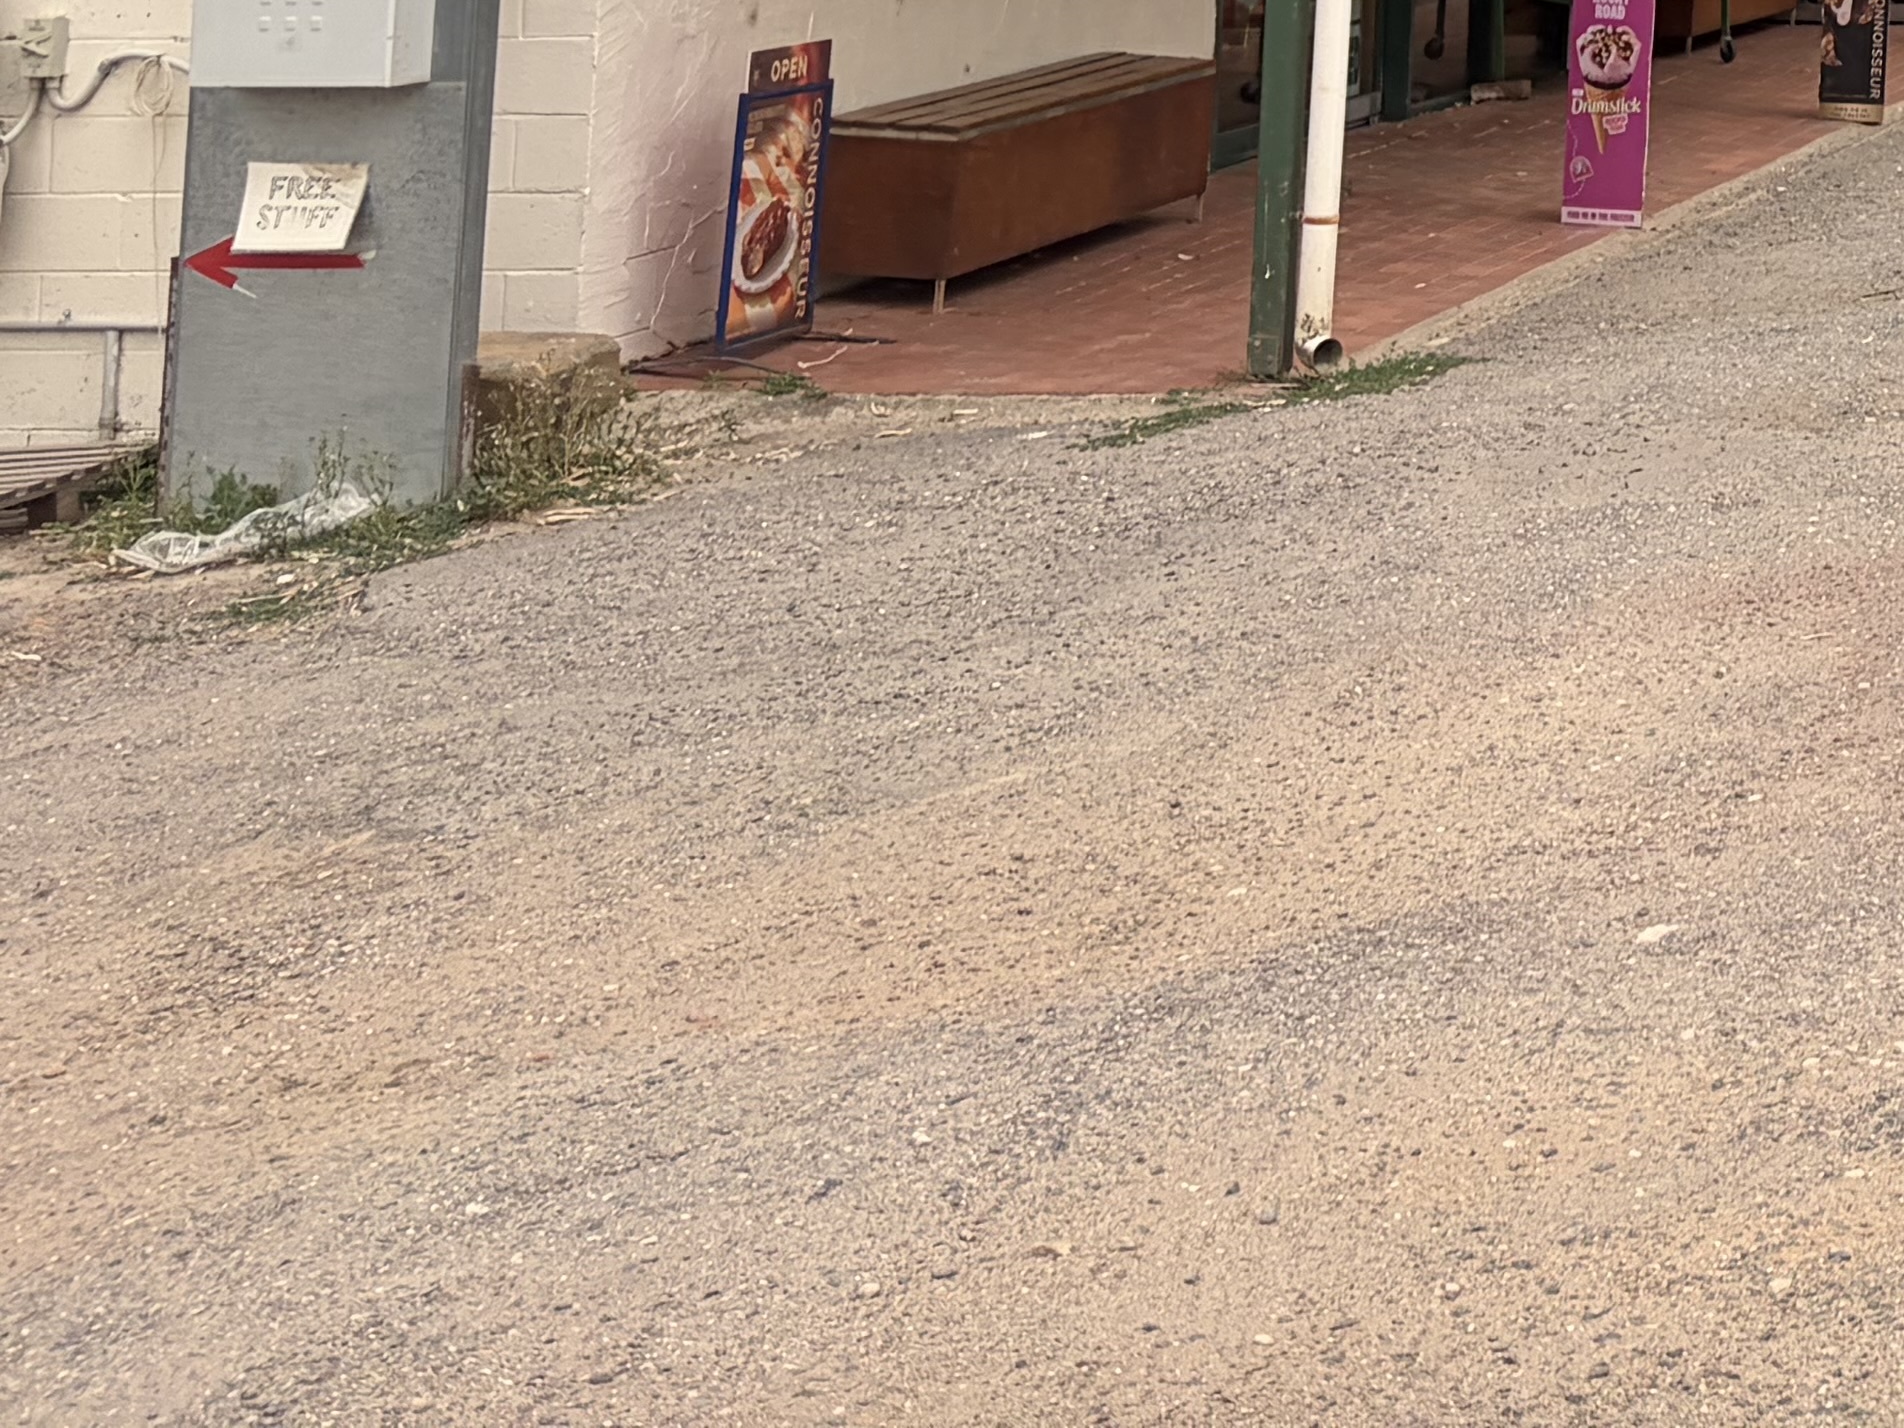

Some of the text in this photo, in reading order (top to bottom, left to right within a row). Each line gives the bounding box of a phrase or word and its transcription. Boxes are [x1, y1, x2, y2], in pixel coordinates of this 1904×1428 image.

[1595, 4, 1625, 20] ROAD
[770, 55, 808, 83] OPEN
[1571, 96, 1641, 115] Drumstick
[268, 175, 341, 200] FREE
[795, 98, 823, 320] CONNOISSEUR
